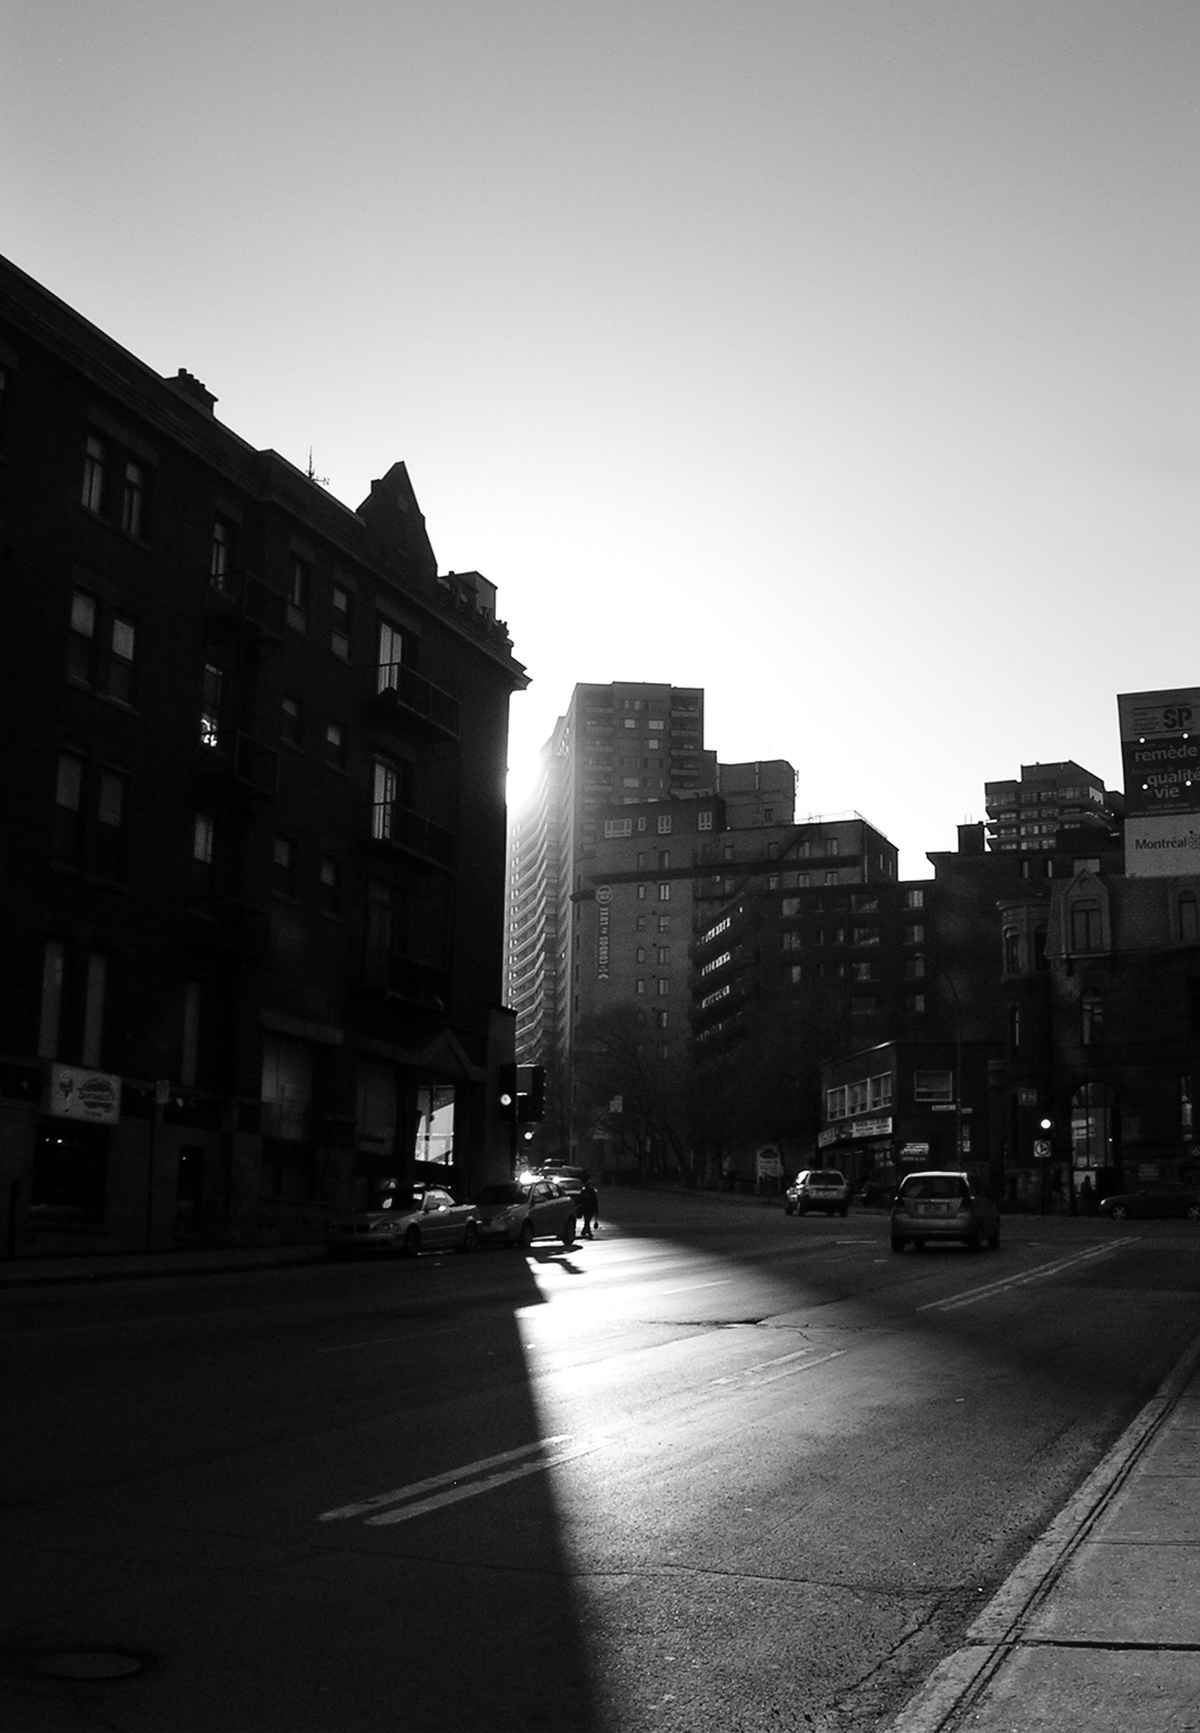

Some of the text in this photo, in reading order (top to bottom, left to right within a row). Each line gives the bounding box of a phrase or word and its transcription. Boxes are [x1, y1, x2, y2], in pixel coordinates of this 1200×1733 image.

[1135, 745, 1199, 762] remède
[1154, 785, 1181, 799] vie
[1135, 837, 1187, 850] Montréal
